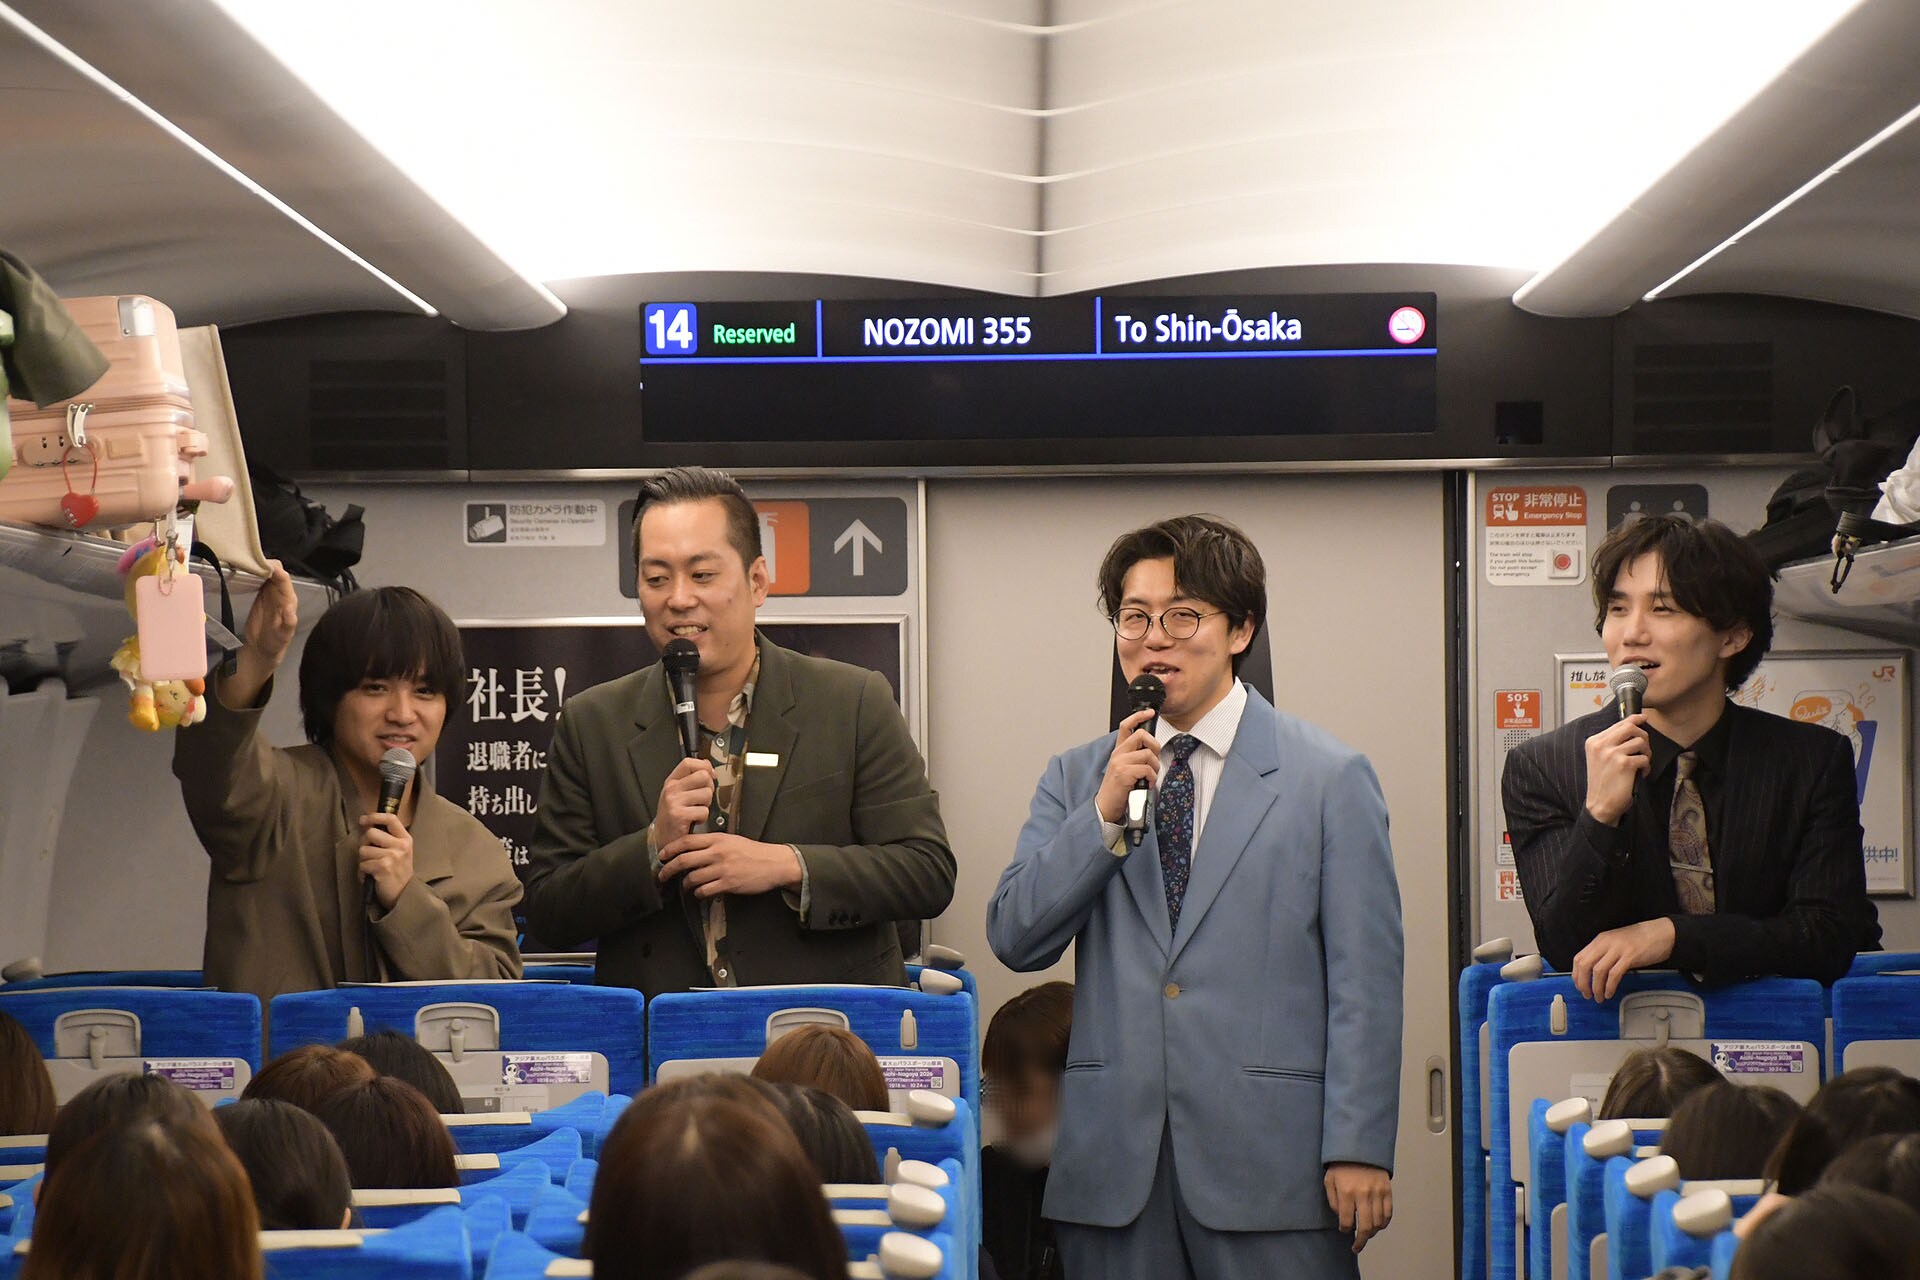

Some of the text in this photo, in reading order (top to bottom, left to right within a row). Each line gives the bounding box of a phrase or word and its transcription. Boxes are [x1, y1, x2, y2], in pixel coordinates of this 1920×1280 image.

[648, 309, 694, 349] 14
[713, 322, 796, 344] Reserved
[863, 316, 1032, 346] NOZOMI 355
[1114, 308, 1302, 343] To Shin-Ōsaka
[1492, 492, 1520, 502] STOP
[1524, 492, 1582, 507] 非常停止
[509, 504, 598, 515] 防犯カメラ作動中
[1523, 511, 1583, 520] Emergency Stop
[1872, 665, 1896, 679] JR
[466, 666, 567, 723] 社長!
[1507, 693, 1529, 702] SOS
[466, 740, 548, 771] 退職者に
[468, 785, 538, 815] 持ち出し
